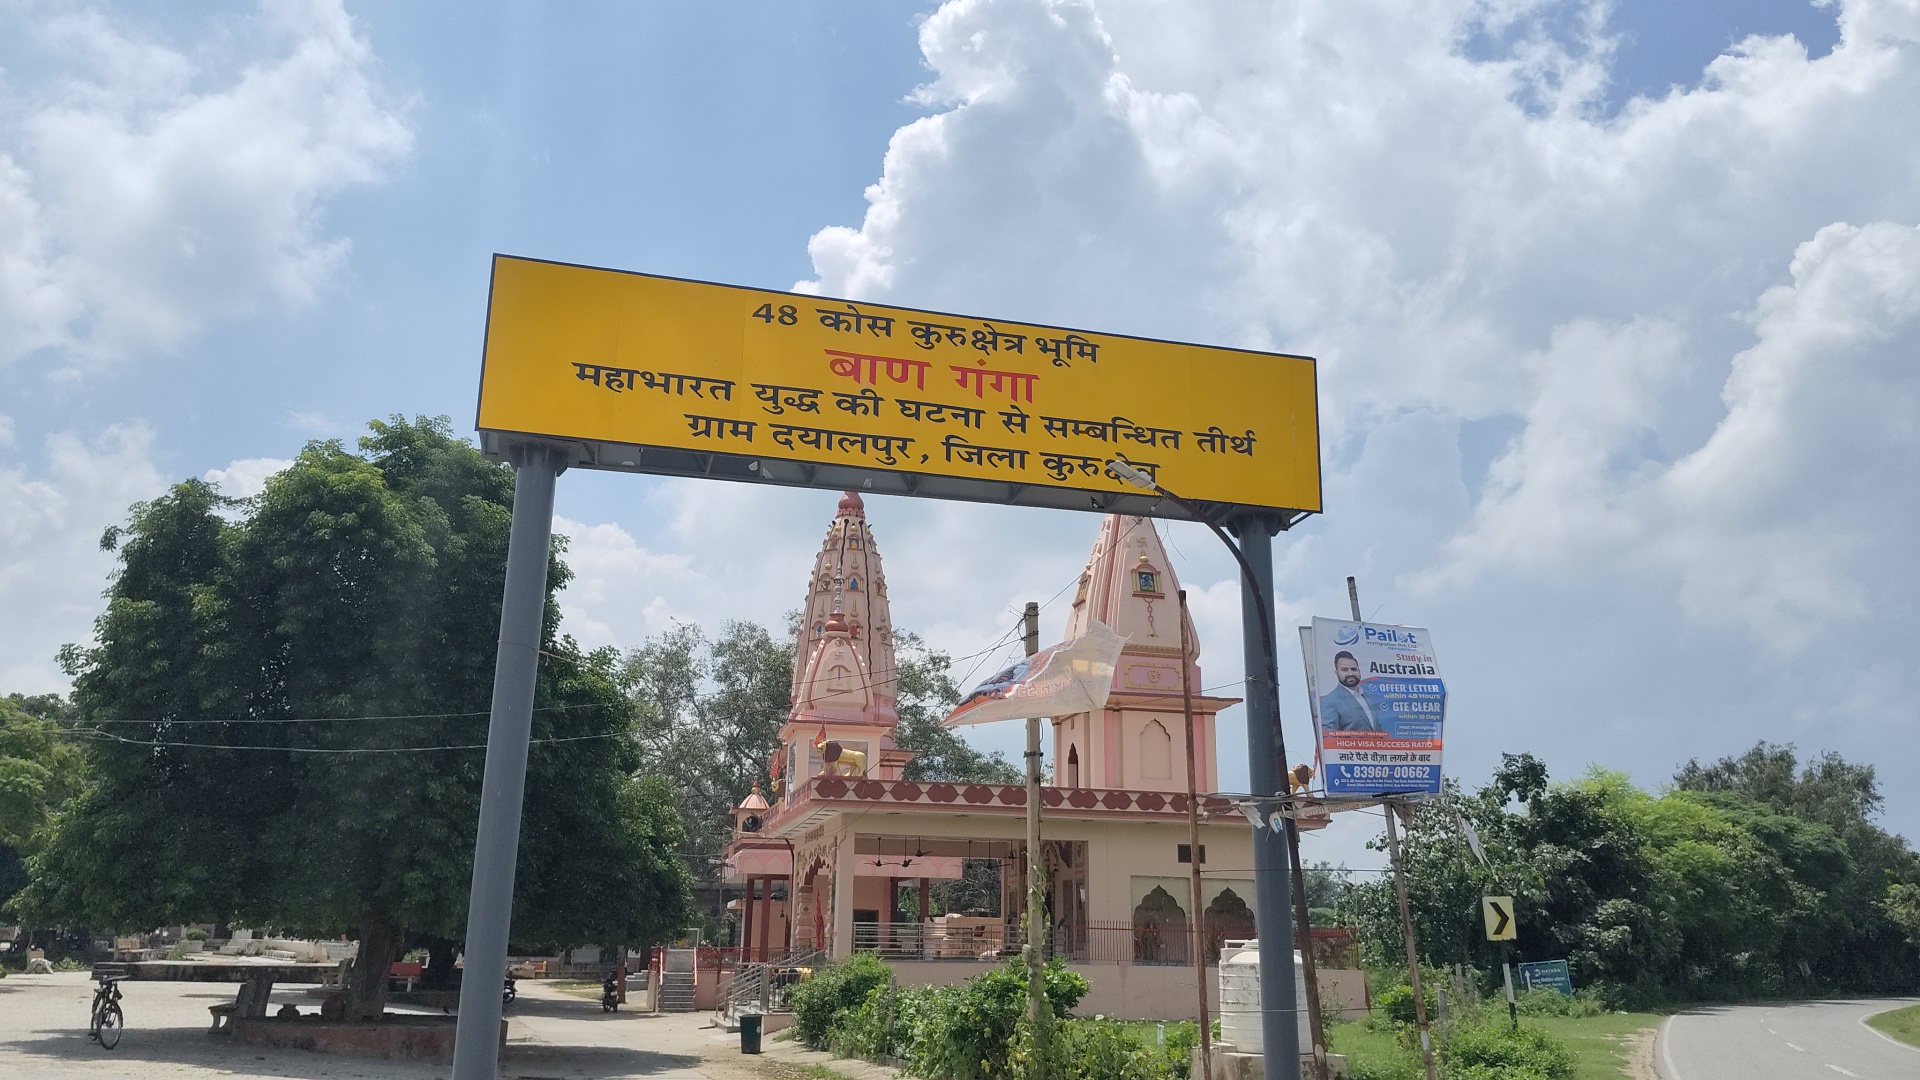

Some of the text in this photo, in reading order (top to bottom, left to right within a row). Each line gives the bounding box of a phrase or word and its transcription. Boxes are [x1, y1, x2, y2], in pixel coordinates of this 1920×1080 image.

[752, 303, 1100, 368] 48 कोस कुरुक्षेत्र भूमि
[824, 348, 1040, 404] बाण गंगा
[571, 361, 1258, 457] महाभारत युद्ध की घटना से सम्बन्धित तीर्थ
[684, 413, 758, 443] ग्राम
[941, 435, 1031, 471] जिला
[1364, 627, 1417, 644] Pailot
[1396, 653, 1421, 663] Study
[1370, 661, 1436, 675] Australia
[1380, 683, 1440, 693] OFFER LETTER
[1392, 701, 1440, 712] GTE CLEAR
[1338, 751, 1354, 762] सारे
[1355, 751, 1369, 762] पैसे
[1389, 752, 1409, 762] लगने
[1410, 752, 1417, 762] के
[1418, 754, 1431, 762] बाद
[1353, 765, 1430, 779] 83960-00662
